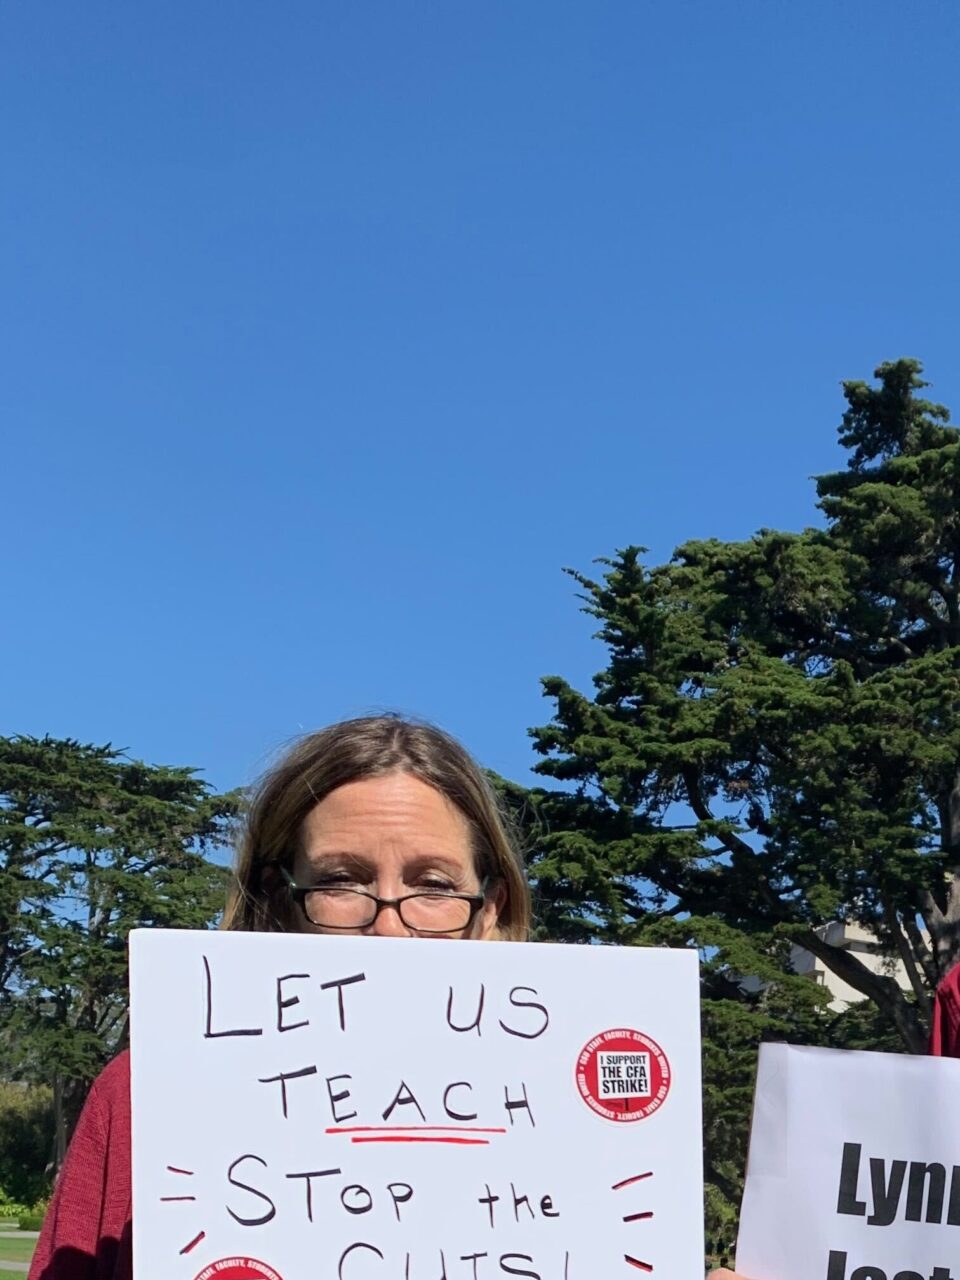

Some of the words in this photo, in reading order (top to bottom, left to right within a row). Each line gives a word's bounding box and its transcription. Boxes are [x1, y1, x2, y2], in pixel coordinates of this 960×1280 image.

[203, 955, 366, 1039] LET
[446, 983, 550, 1040] US
[601, 1066, 622, 1079] THE
[626, 1066, 647, 1078] CFA
[606, 1055, 647, 1065] SUPPORT
[258, 1065, 536, 1127] TEACH
[602, 1079, 648, 1094] STRIKE!
[478, 1183, 560, 1229] the
